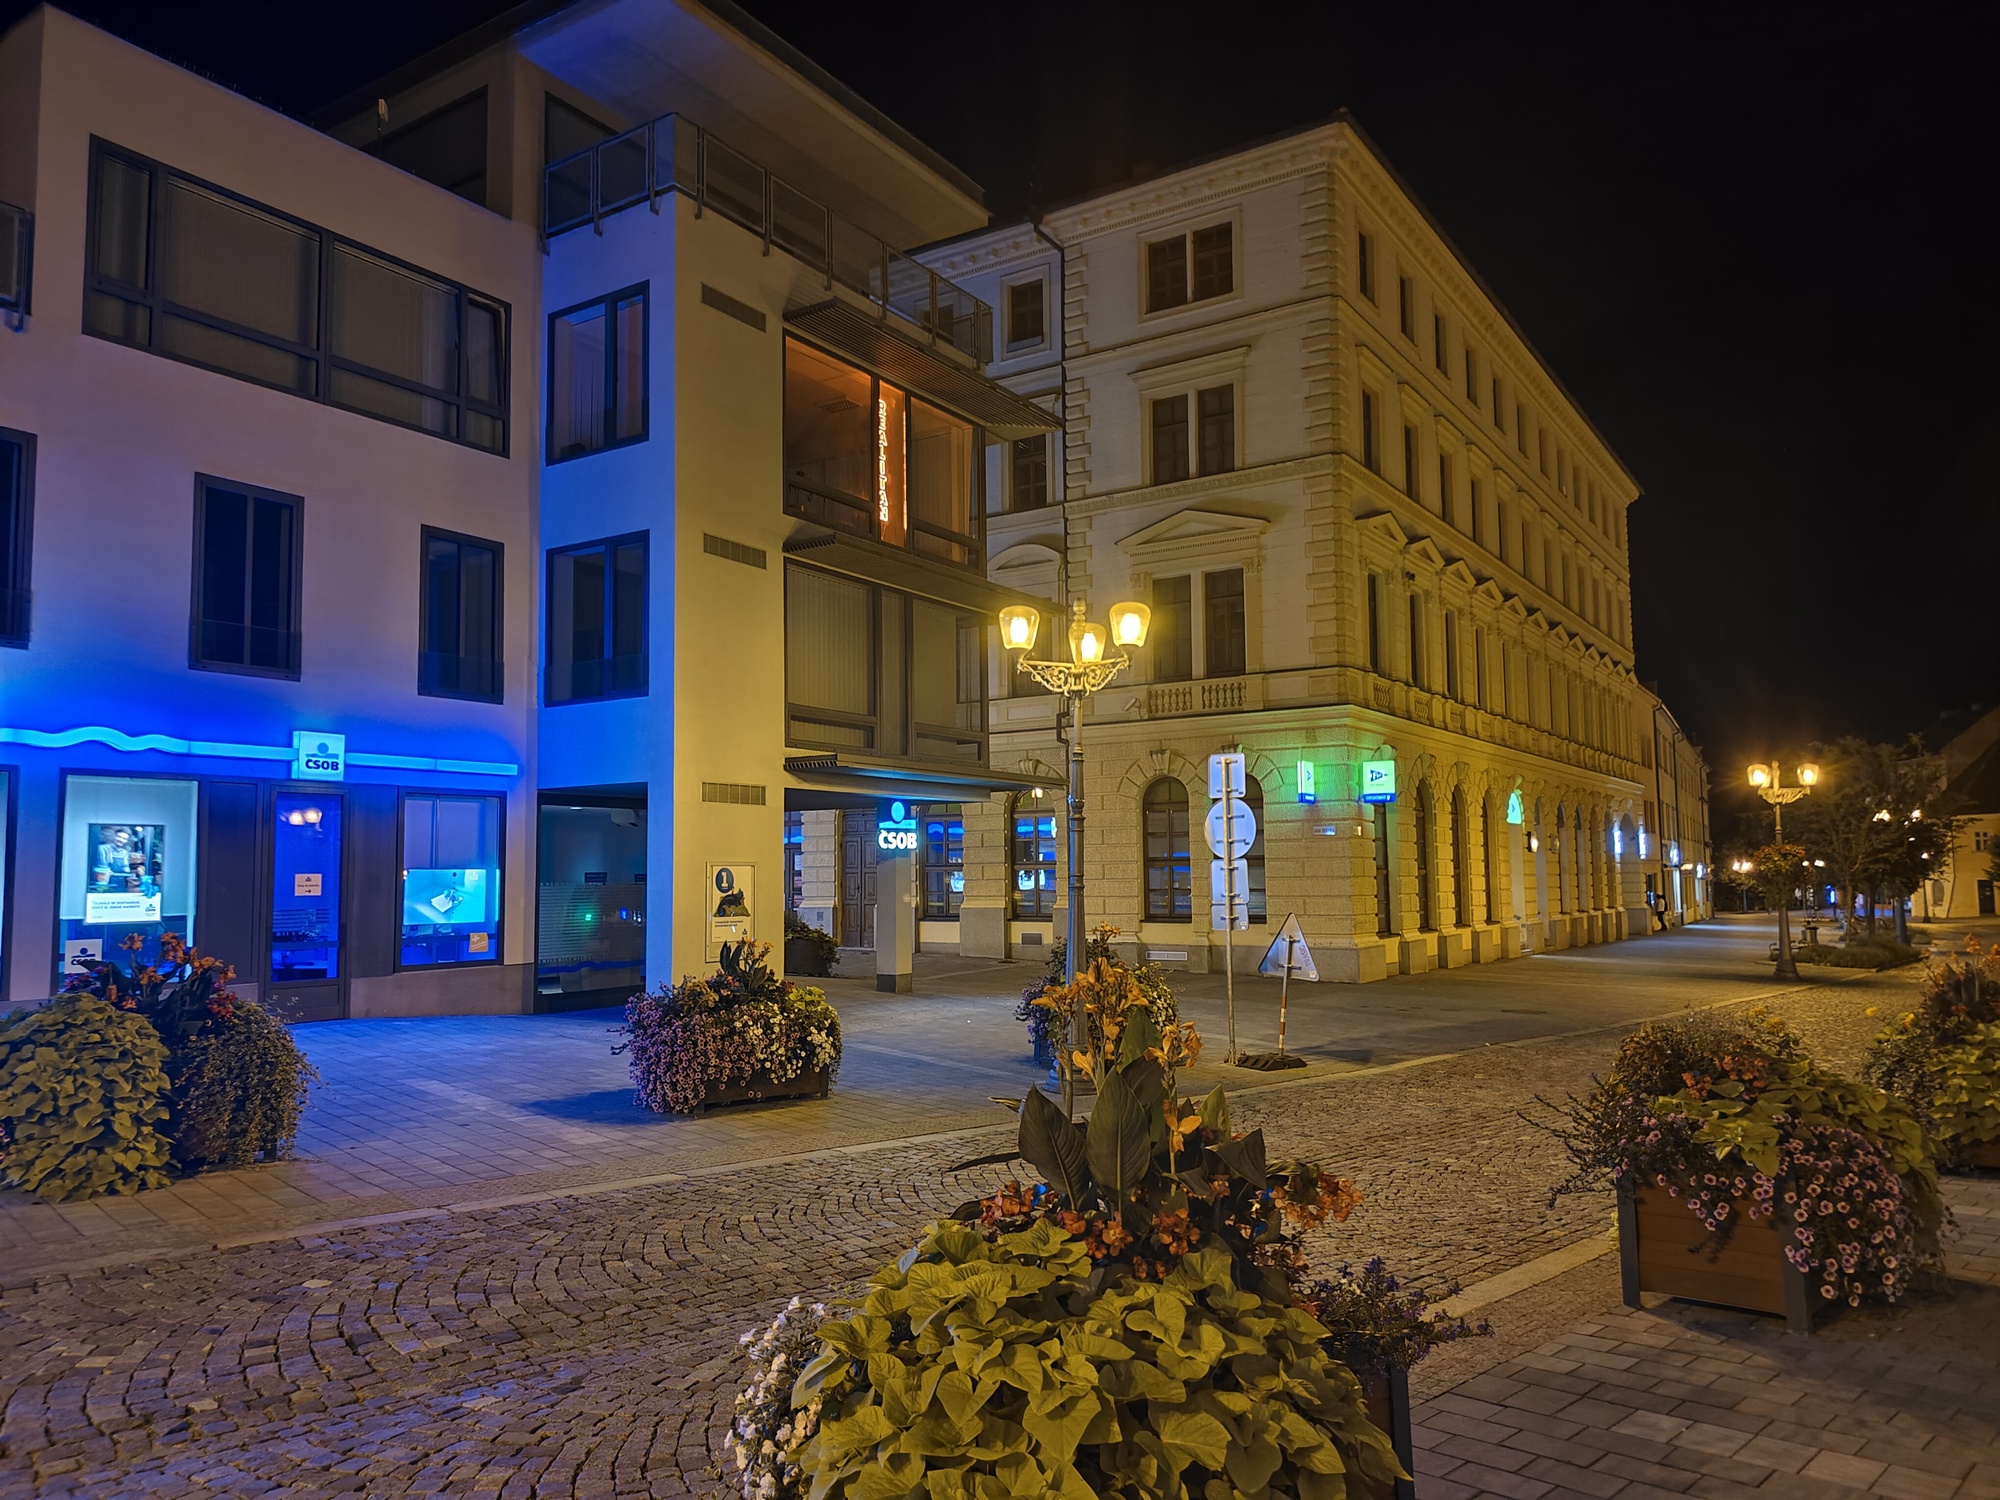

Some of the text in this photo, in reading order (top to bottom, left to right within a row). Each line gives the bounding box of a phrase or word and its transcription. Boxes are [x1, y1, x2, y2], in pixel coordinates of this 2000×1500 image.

[305, 757, 340, 771] ČSOB
[878, 829, 918, 849] ČSOB
[721, 871, 729, 888] 1
